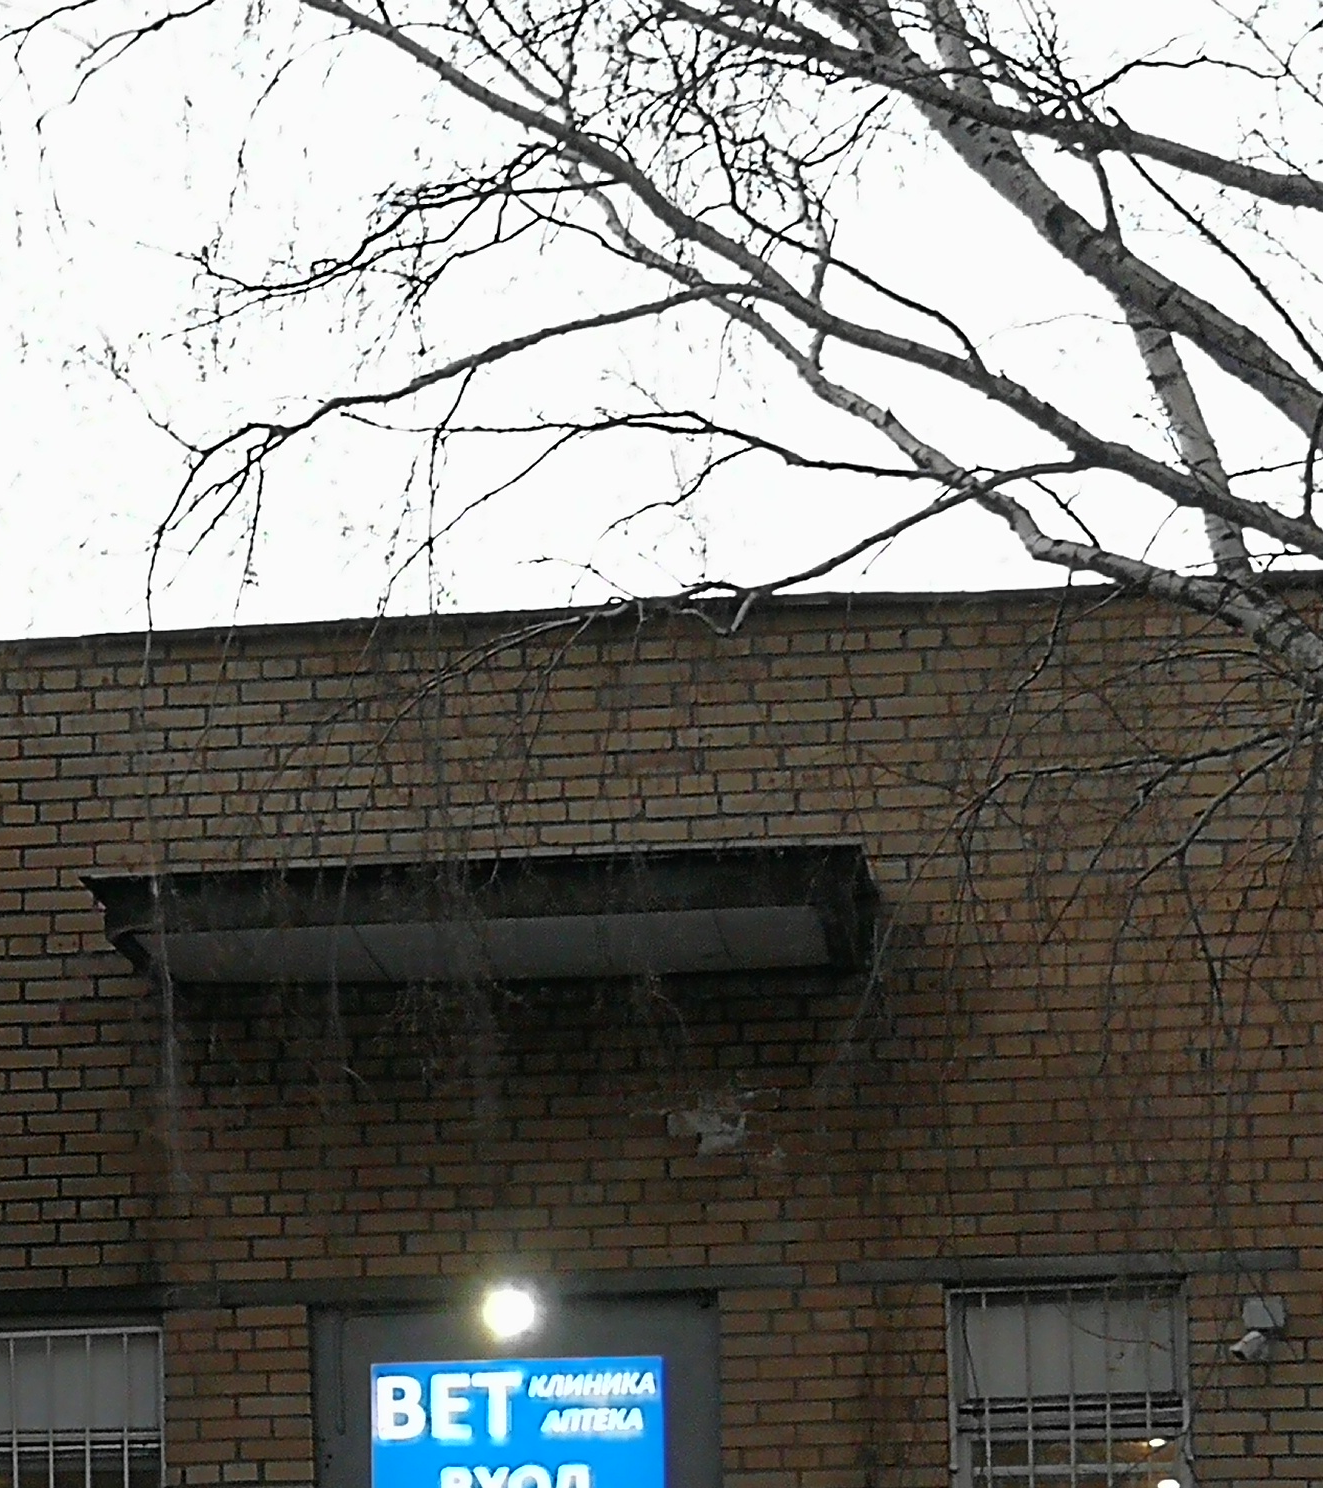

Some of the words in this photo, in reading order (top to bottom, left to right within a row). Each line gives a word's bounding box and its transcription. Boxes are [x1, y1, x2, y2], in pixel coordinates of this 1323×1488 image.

[528, 1372, 656, 1398] КЛИНИКА
[376, 1371, 523, 1441] ВЕТ
[540, 1408, 644, 1433] АПТЕКА
